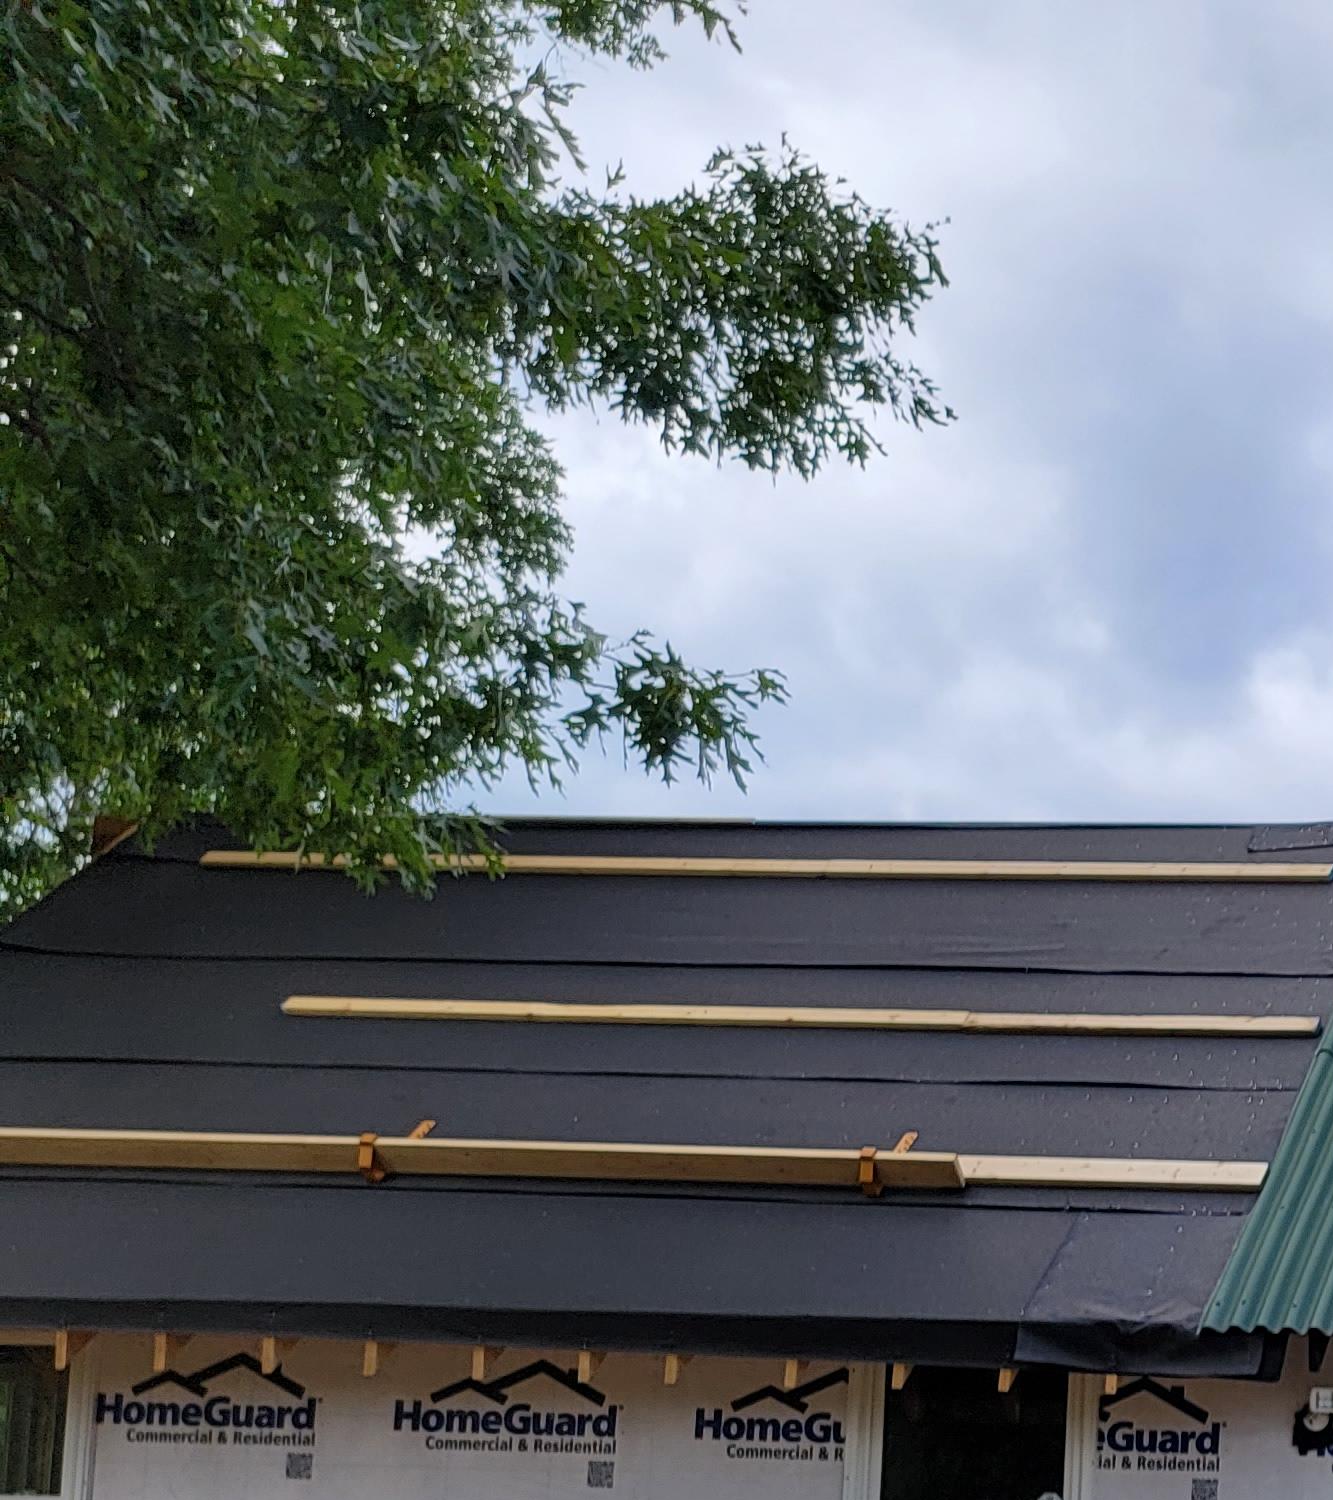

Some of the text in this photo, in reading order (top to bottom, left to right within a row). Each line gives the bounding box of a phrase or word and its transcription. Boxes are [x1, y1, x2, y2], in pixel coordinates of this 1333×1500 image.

[95, 1392, 316, 1429] HomeGuard
[393, 1399, 617, 1437] HomeGuard
[127, 1427, 315, 1447] Commercial & Residential
[425, 1435, 616, 1455] Commercial & Residential
[726, 1444, 813, 1461] Commercial
[818, 1447, 828, 1461] &
[1121, 1456, 1131, 1470] &
[1137, 1456, 1219, 1472] Residential
